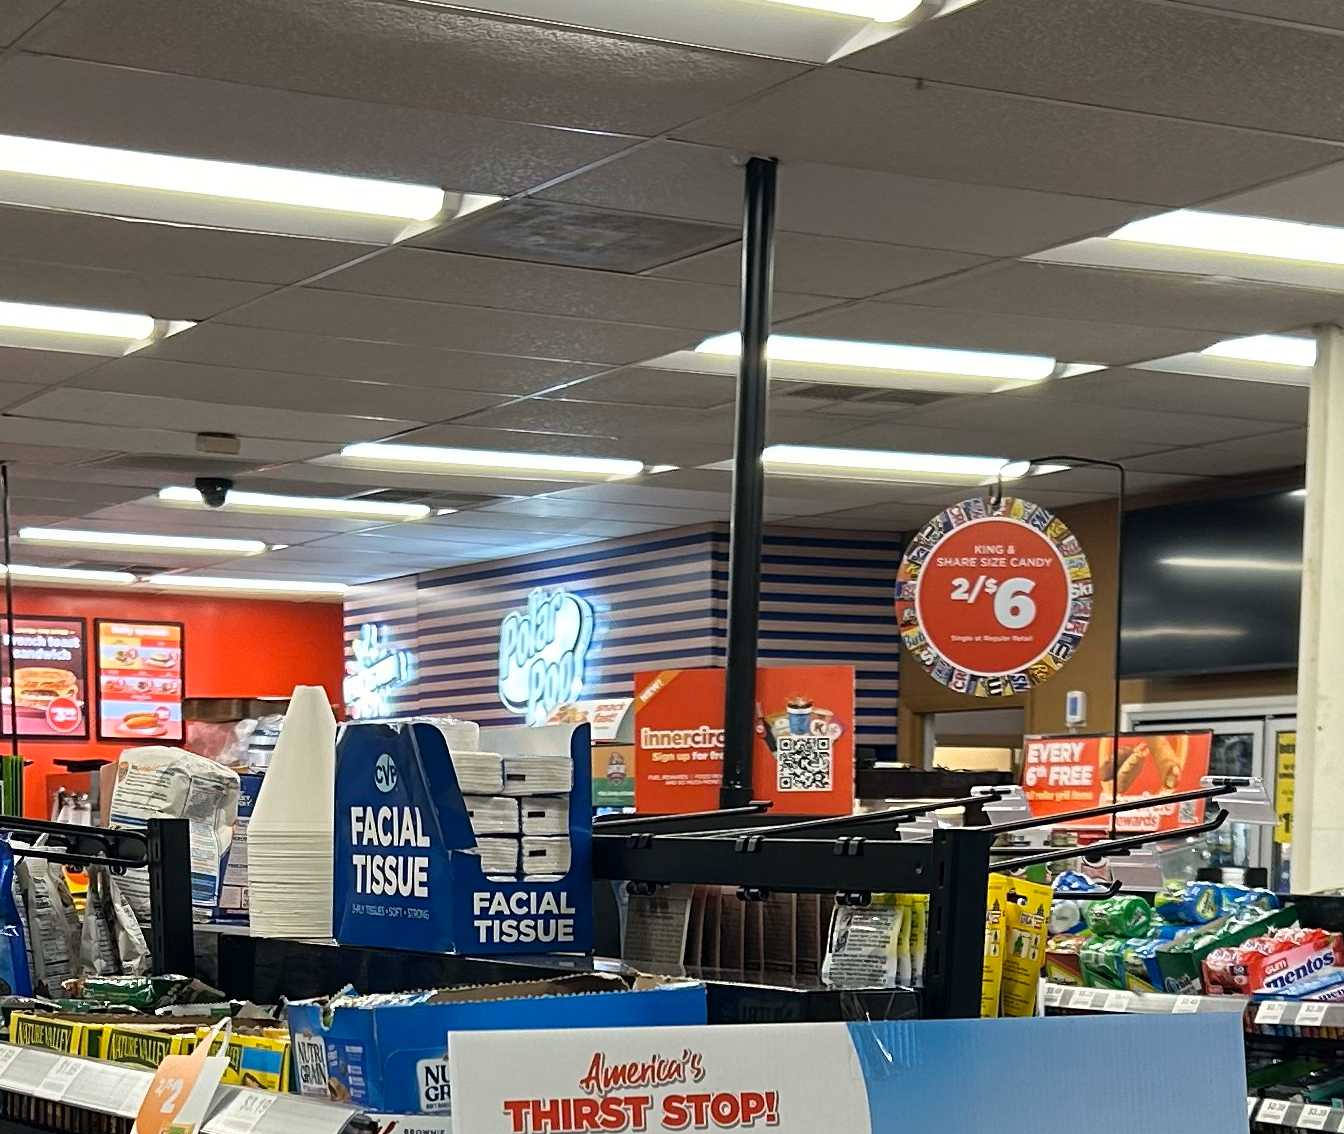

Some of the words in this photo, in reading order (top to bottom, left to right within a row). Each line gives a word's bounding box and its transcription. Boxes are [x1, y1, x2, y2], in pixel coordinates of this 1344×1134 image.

[936, 557, 977, 567] SHARE
[980, 557, 1007, 567] SIZE
[1010, 557, 1053, 567] CANDY
[974, 545, 1004, 555] KING
[1006, 545, 1016, 555] &
[950, 575, 1036, 629] 2/$6
[504, 590, 563, 667] Polar
[652, 752, 675, 763] Sign
[677, 753, 690, 763] up
[692, 751, 708, 761] for
[1027, 742, 1084, 764] EVERY
[375, 756, 397, 787] CVP
[1048, 765, 1094, 786] FREE
[350, 806, 431, 848] FACIAL
[352, 854, 429, 898] TISSUE
[473, 891, 576, 916] FACIAL
[473, 919, 574, 943] TISSUE
[1264, 950, 1336, 989] mentos
[111, 1032, 136, 1061] NATURE
[137, 1036, 170, 1066] VALLEY
[297, 1040, 325, 1067] NUTRI
[299, 1058, 329, 1087] GRAIN
[579, 1050, 706, 1093] America's
[504, 1096, 652, 1134] THIRST
[661, 1091, 780, 1128] STOP!
